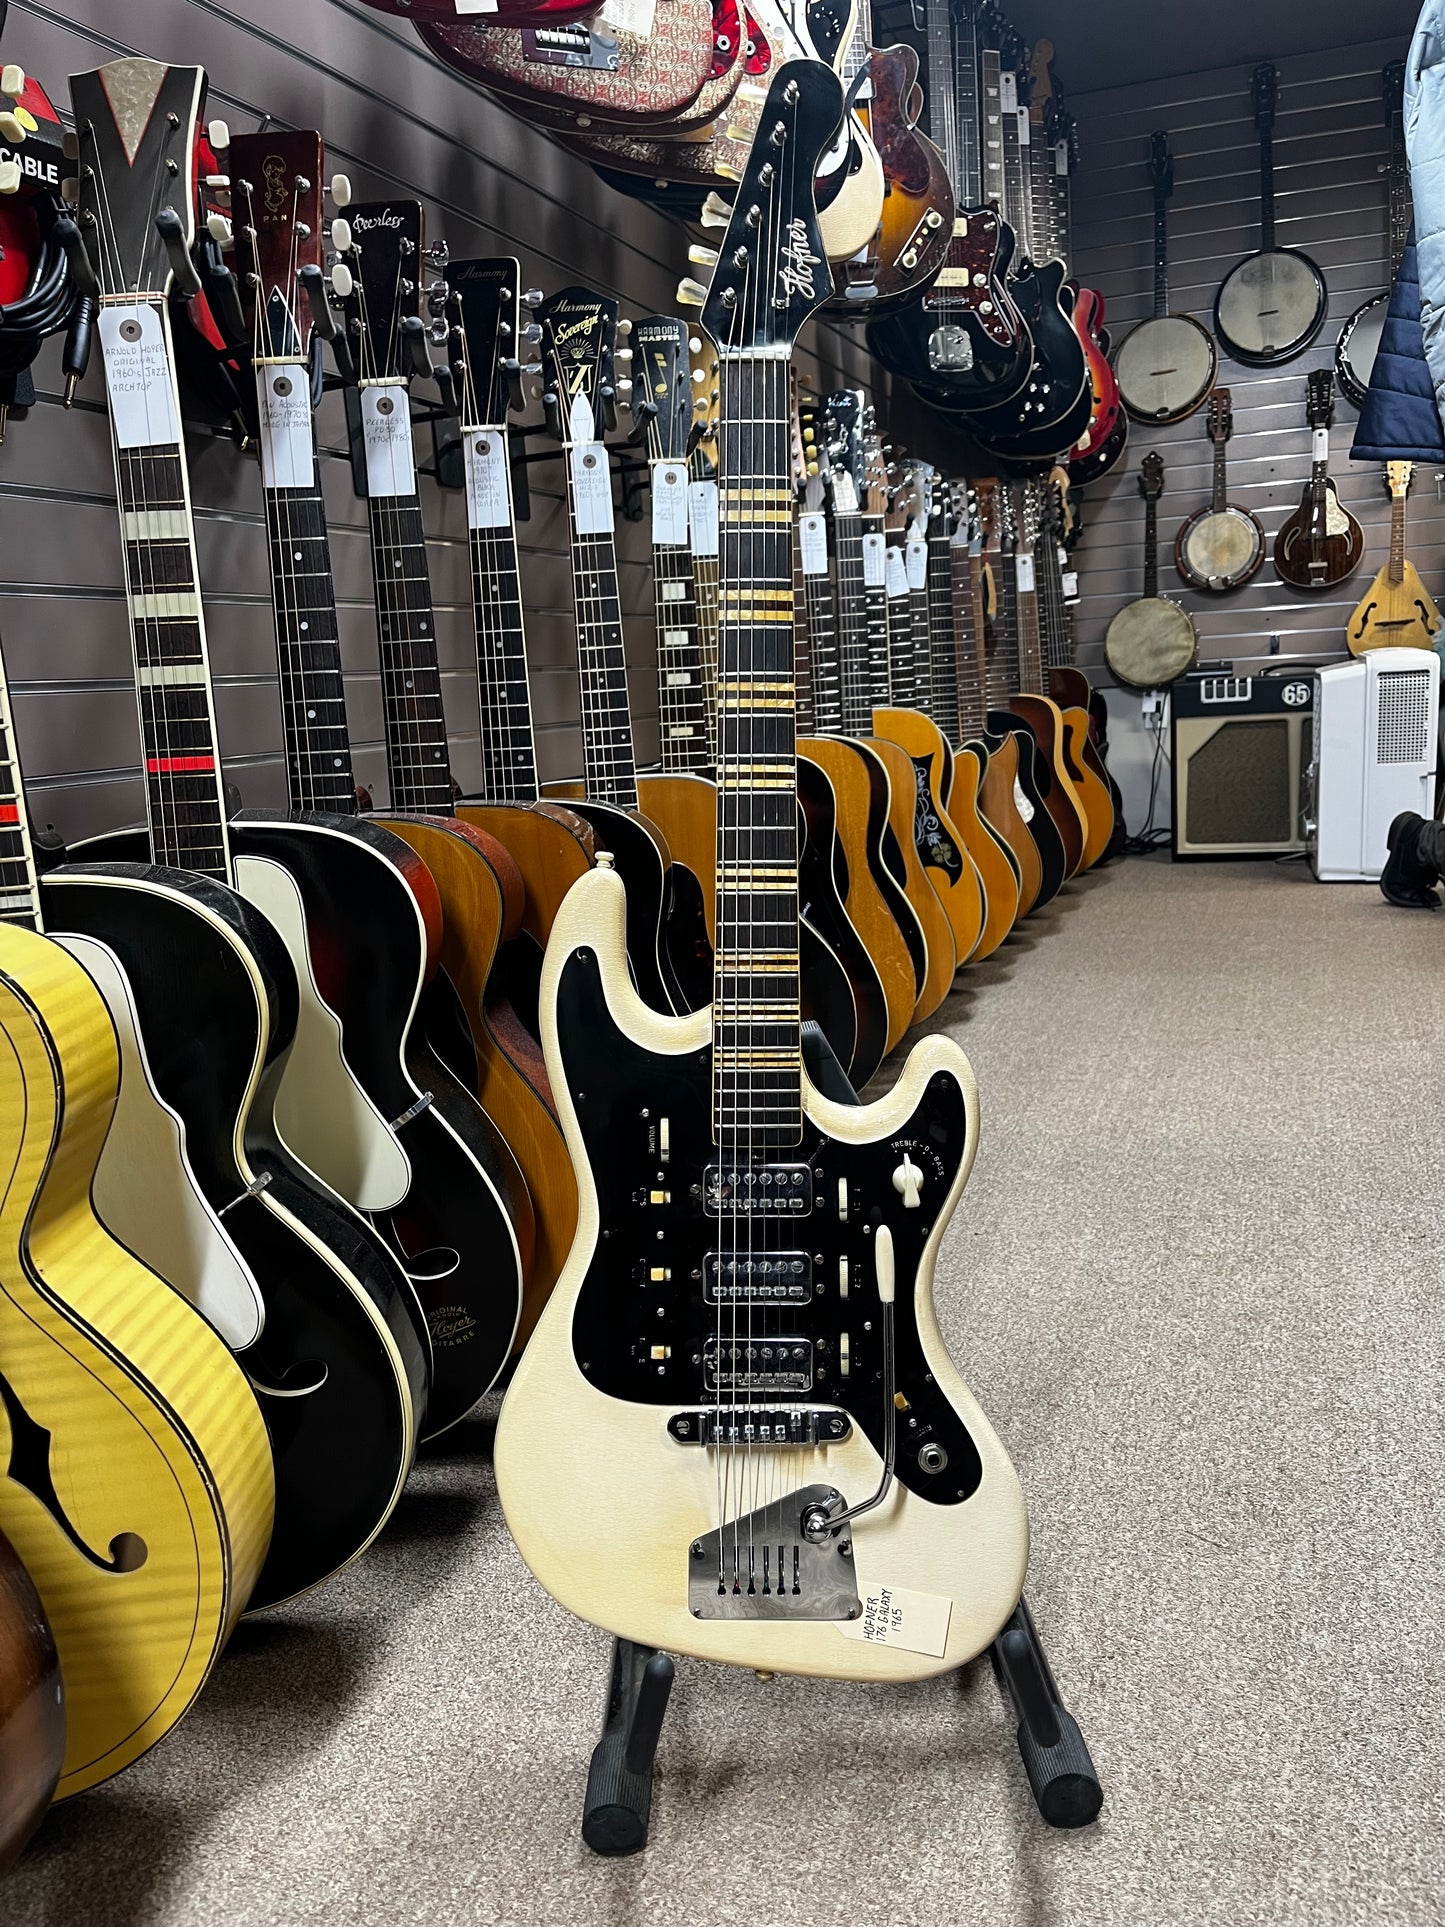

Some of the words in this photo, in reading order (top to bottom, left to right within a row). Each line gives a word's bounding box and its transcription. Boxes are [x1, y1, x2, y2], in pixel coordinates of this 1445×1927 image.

[263, 214, 288, 222] PAN
[352, 208, 405, 234] Peerless
[778, 217, 822, 300] Hofner
[457, 265, 508, 281] Harmony
[548, 299, 603, 315] Harmony
[554, 314, 599, 345] Sovereign
[637, 325, 679, 336] HARMONY
[638, 334, 680, 342] MASTER
[105, 347, 137, 356] ARNOLD
[113, 356, 157, 366] ORIGINAL
[144, 366, 167, 377] JAZZ
[1284, 683, 1308, 704] 65
[648, 1125, 656, 1154] VOLUME
[877, 1587, 893, 1624] GALAXY
[863, 1596, 880, 1641] HOFNER
[891, 1607, 903, 1633] 1965
[875, 1625, 887, 1642] 176
